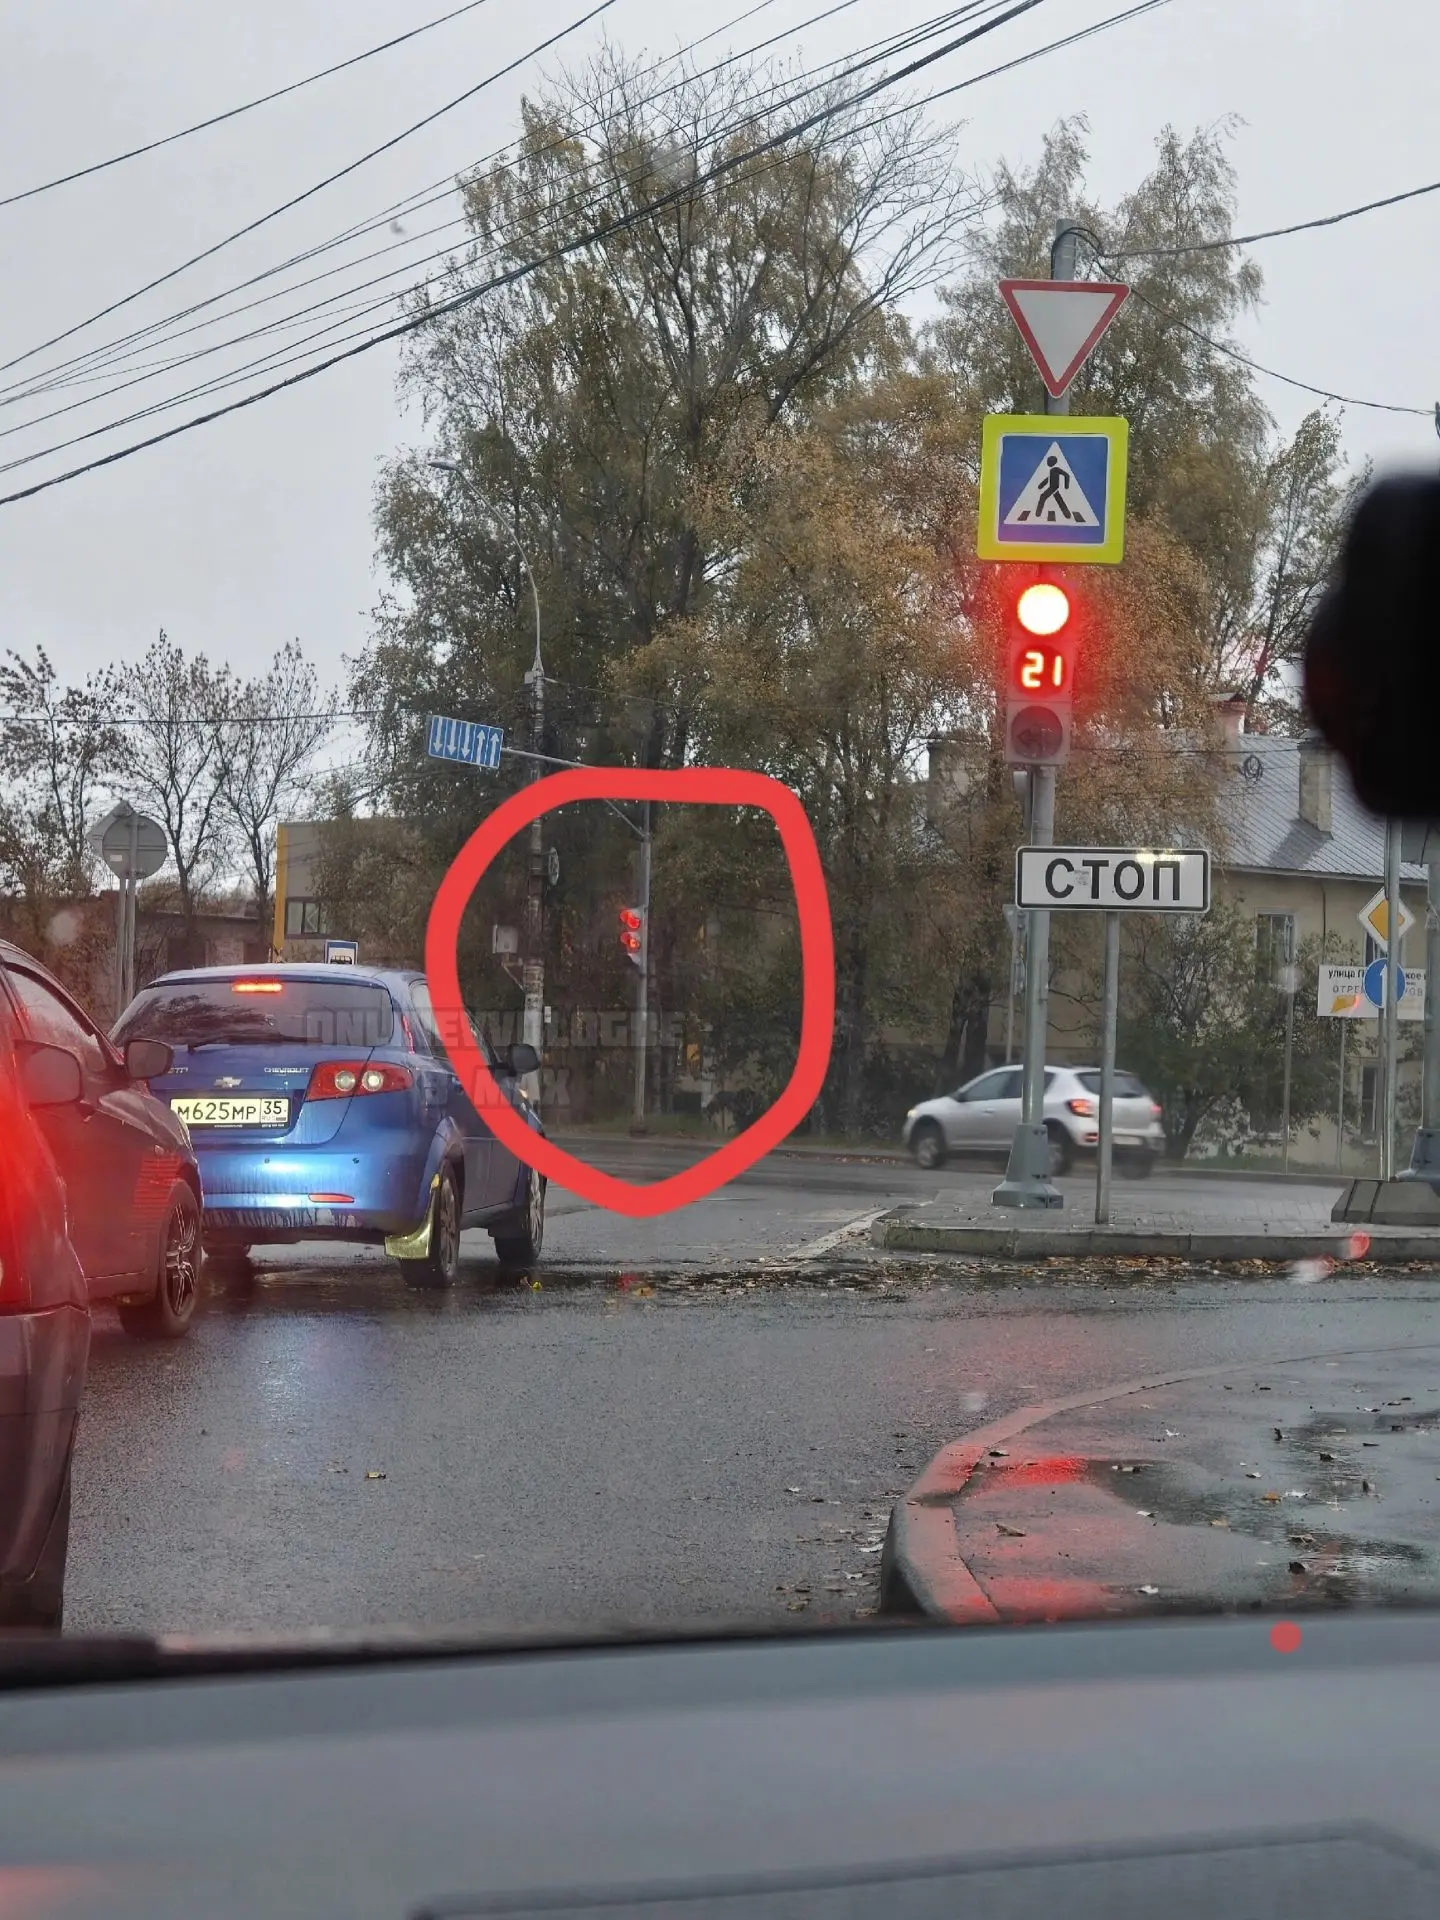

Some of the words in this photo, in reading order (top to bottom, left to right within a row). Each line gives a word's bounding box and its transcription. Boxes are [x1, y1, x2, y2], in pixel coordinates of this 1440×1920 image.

[1021, 651, 1062, 688] 21
[1044, 858, 1181, 901] СТОП
[1328, 969, 1355, 980] улица
[1332, 984, 1363, 994] ОТРЕ
[263, 1101, 282, 1115] 35
